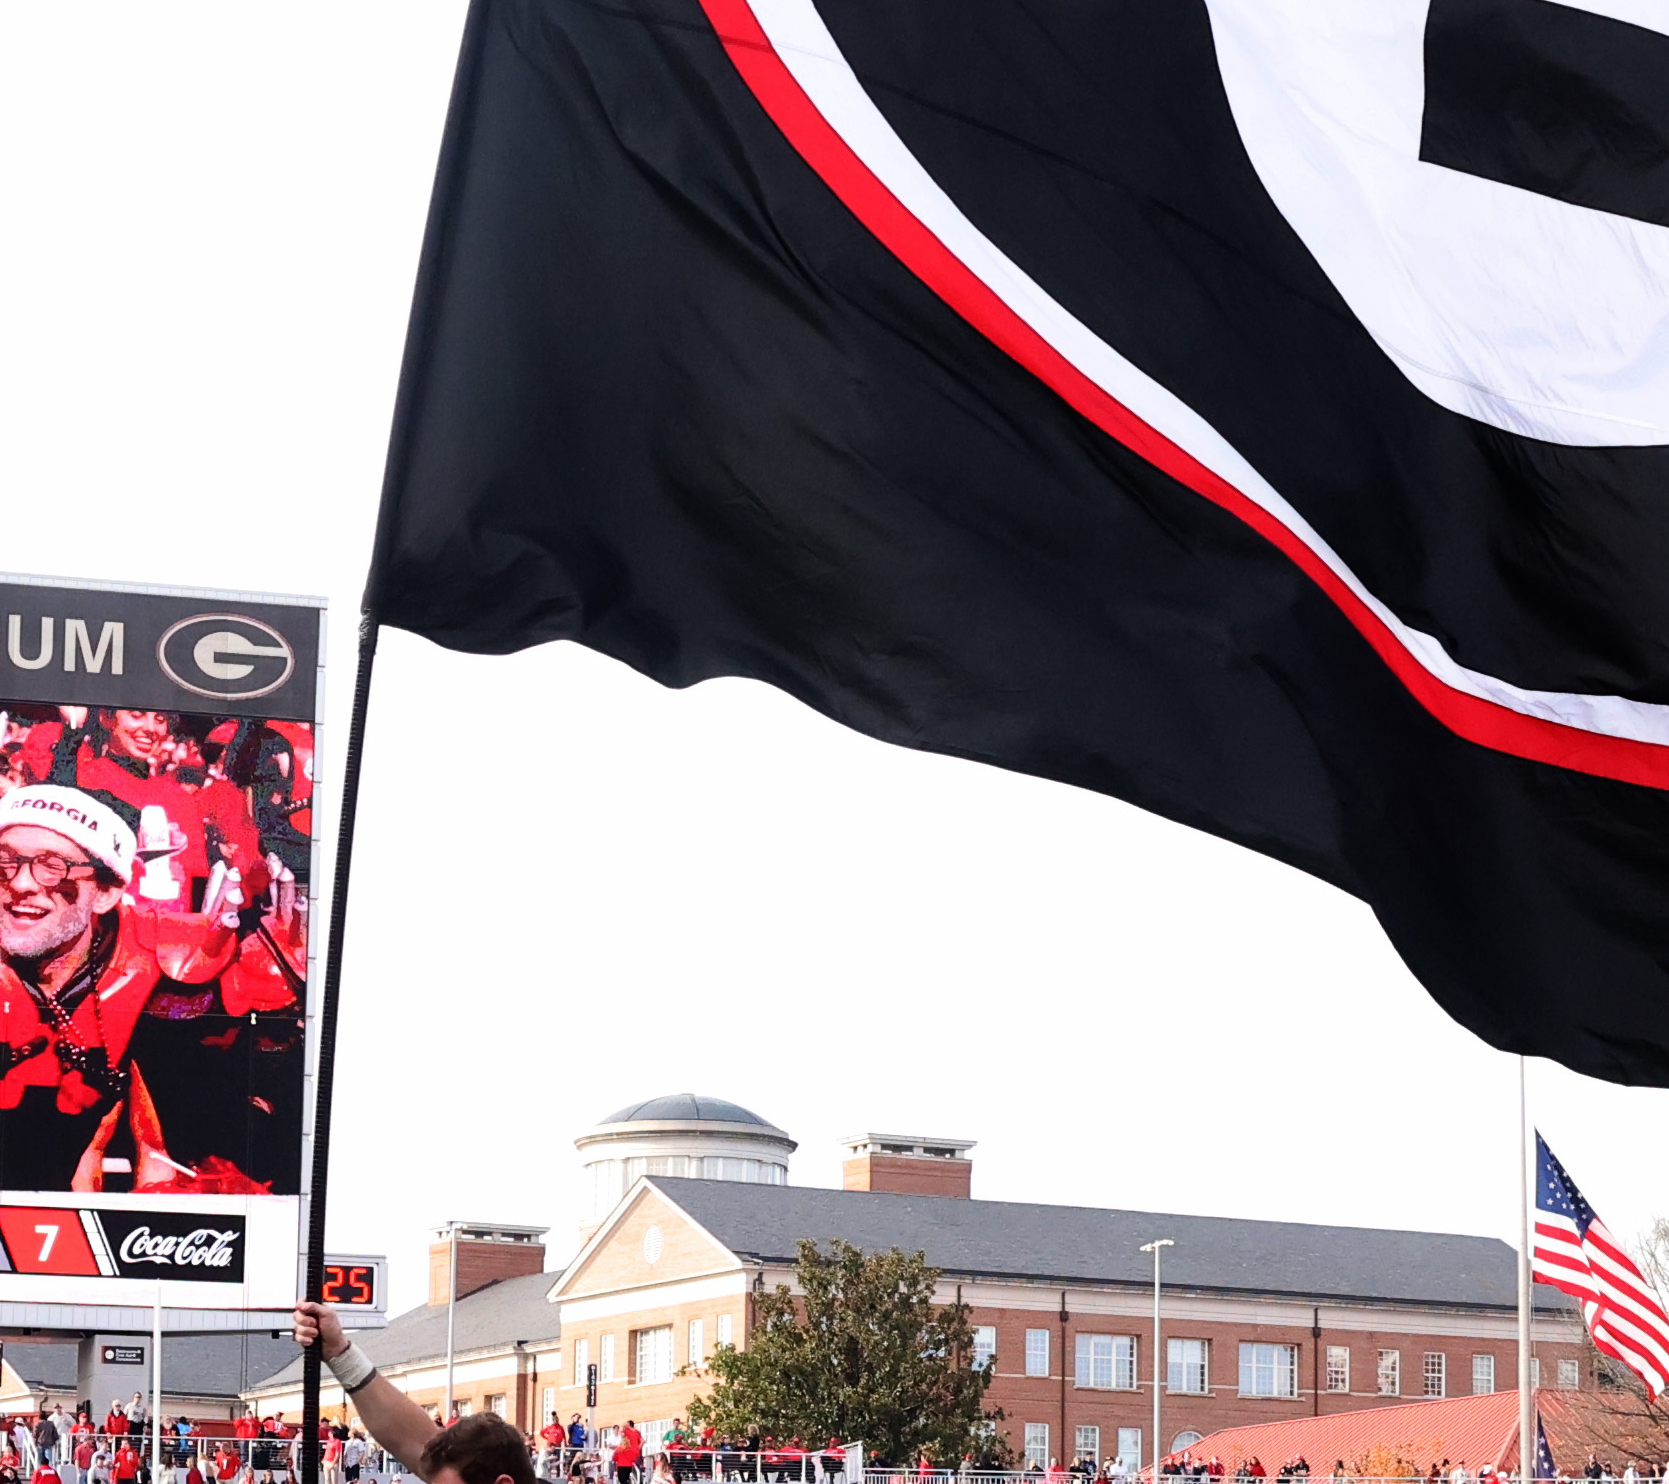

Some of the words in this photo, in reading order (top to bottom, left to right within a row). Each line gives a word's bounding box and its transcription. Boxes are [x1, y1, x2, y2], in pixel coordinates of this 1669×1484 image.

[35, 1225, 61, 1261] 7
[120, 1226, 241, 1267] Coca-Cola
[321, 1267, 371, 1304] 25
